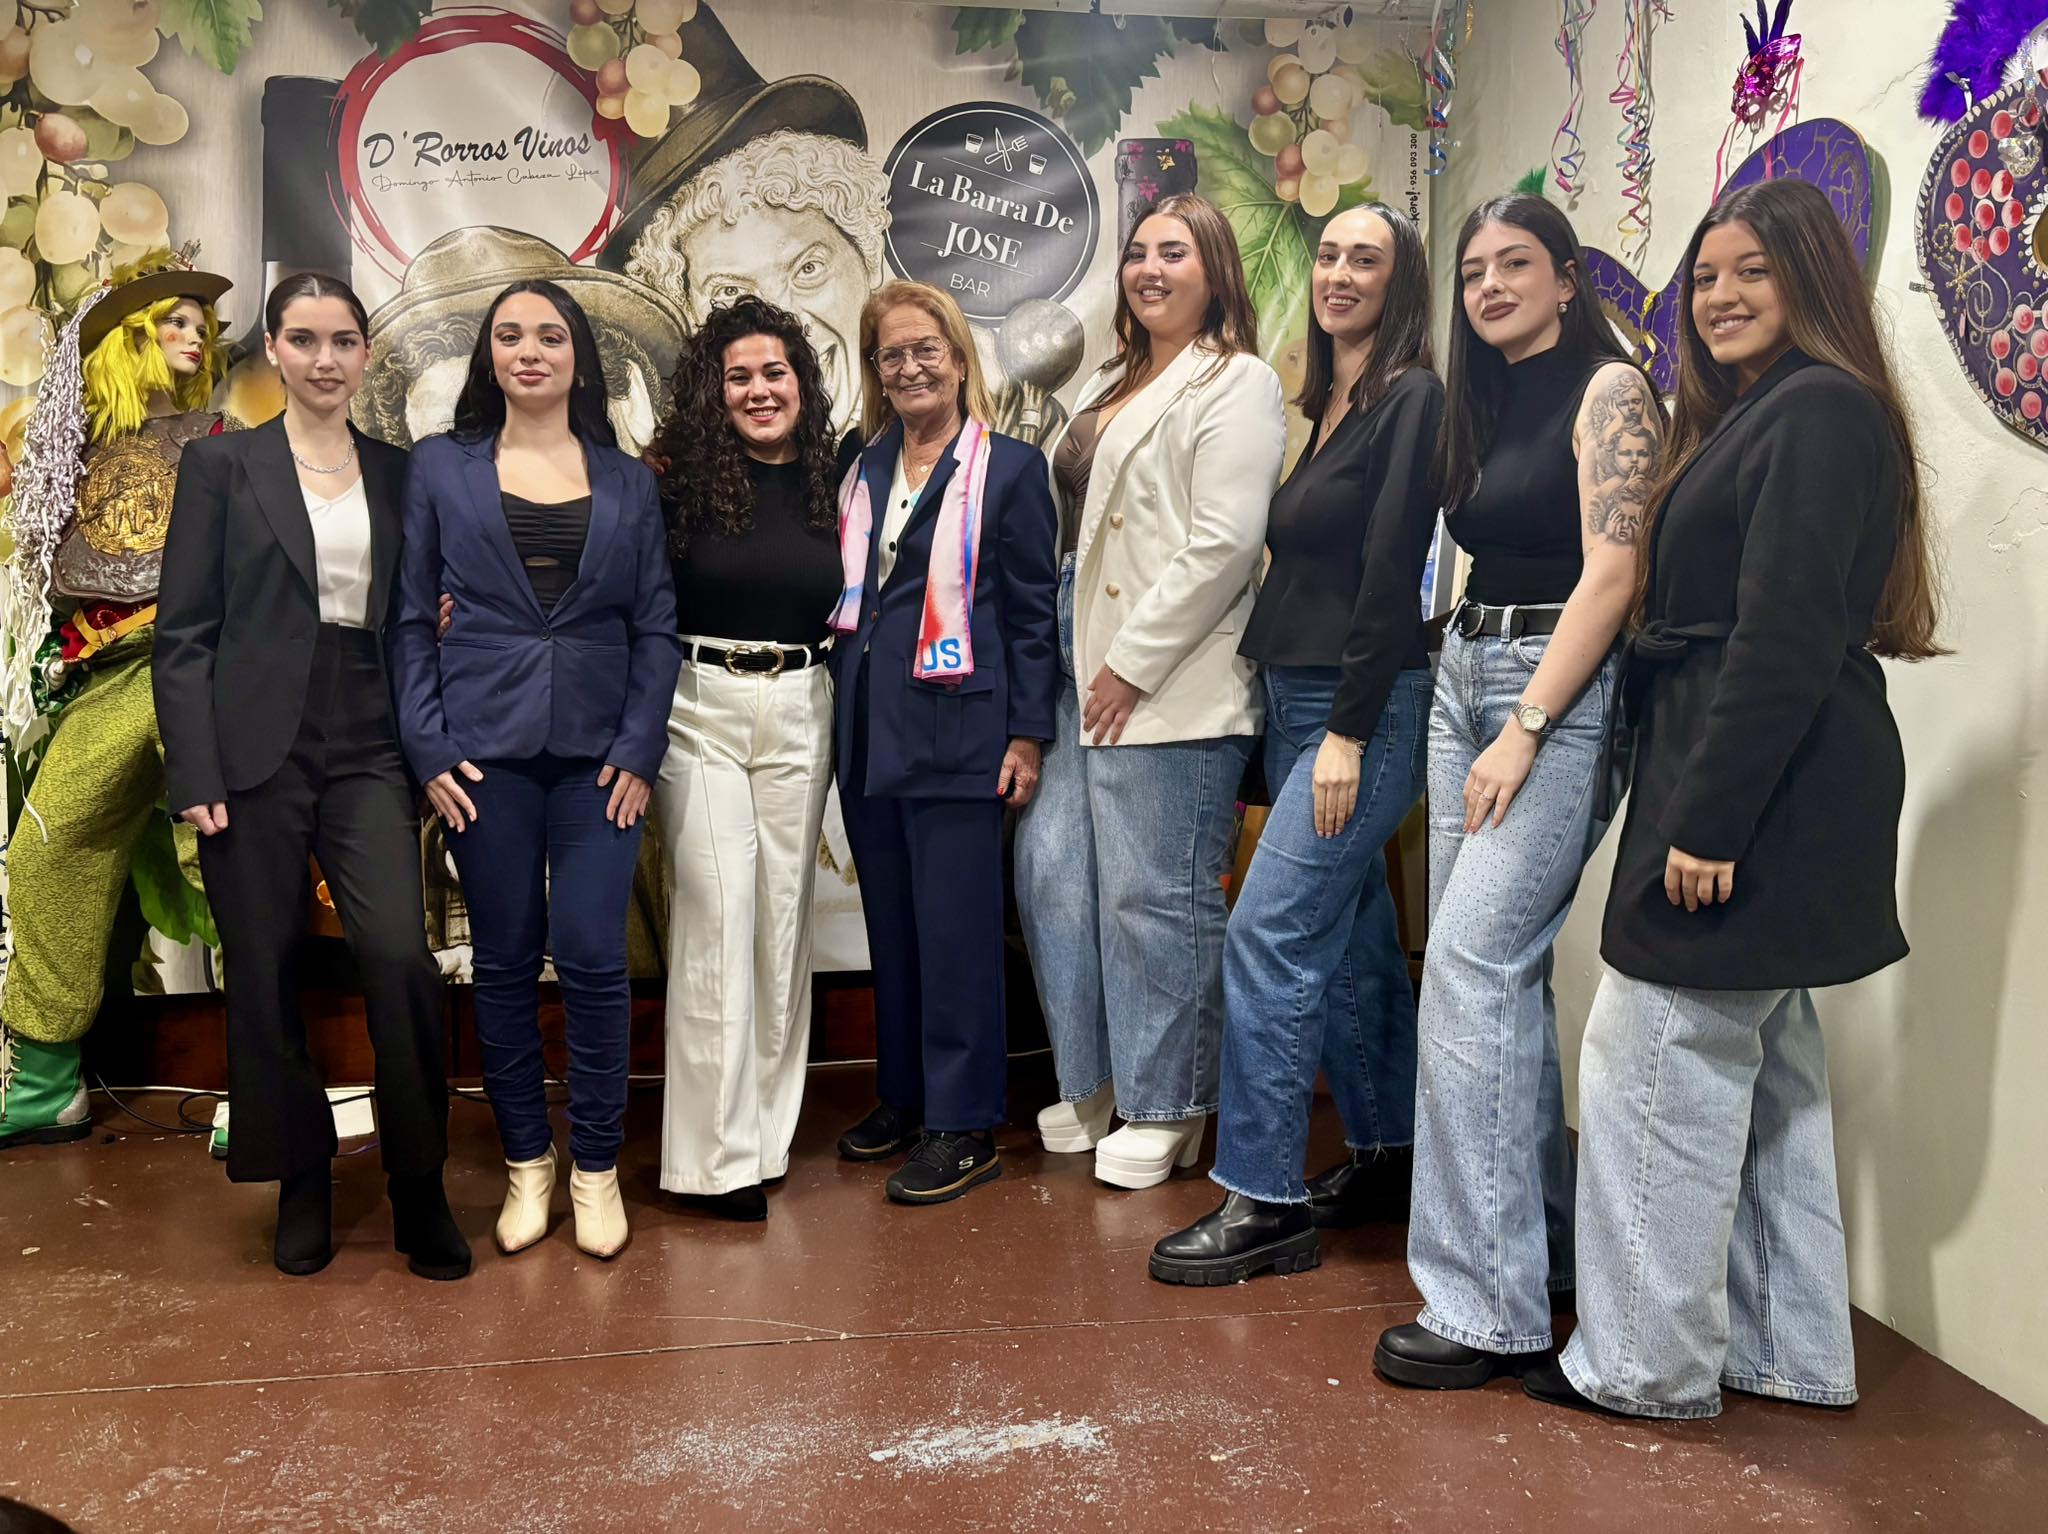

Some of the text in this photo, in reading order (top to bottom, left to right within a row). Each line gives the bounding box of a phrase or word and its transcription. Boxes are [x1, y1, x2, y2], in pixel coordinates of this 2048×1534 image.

[513, 125, 592, 162] Vinos
[1409, 132, 1418, 149] 300
[1409, 151, 1418, 168] 093
[371, 173, 440, 192] Domingo
[445, 169, 503, 188] Antonio
[1409, 169, 1418, 186] 956
[908, 160, 1074, 235] La Barra De
[937, 220, 1022, 268] JOSE
[950, 273, 990, 297] BAR
